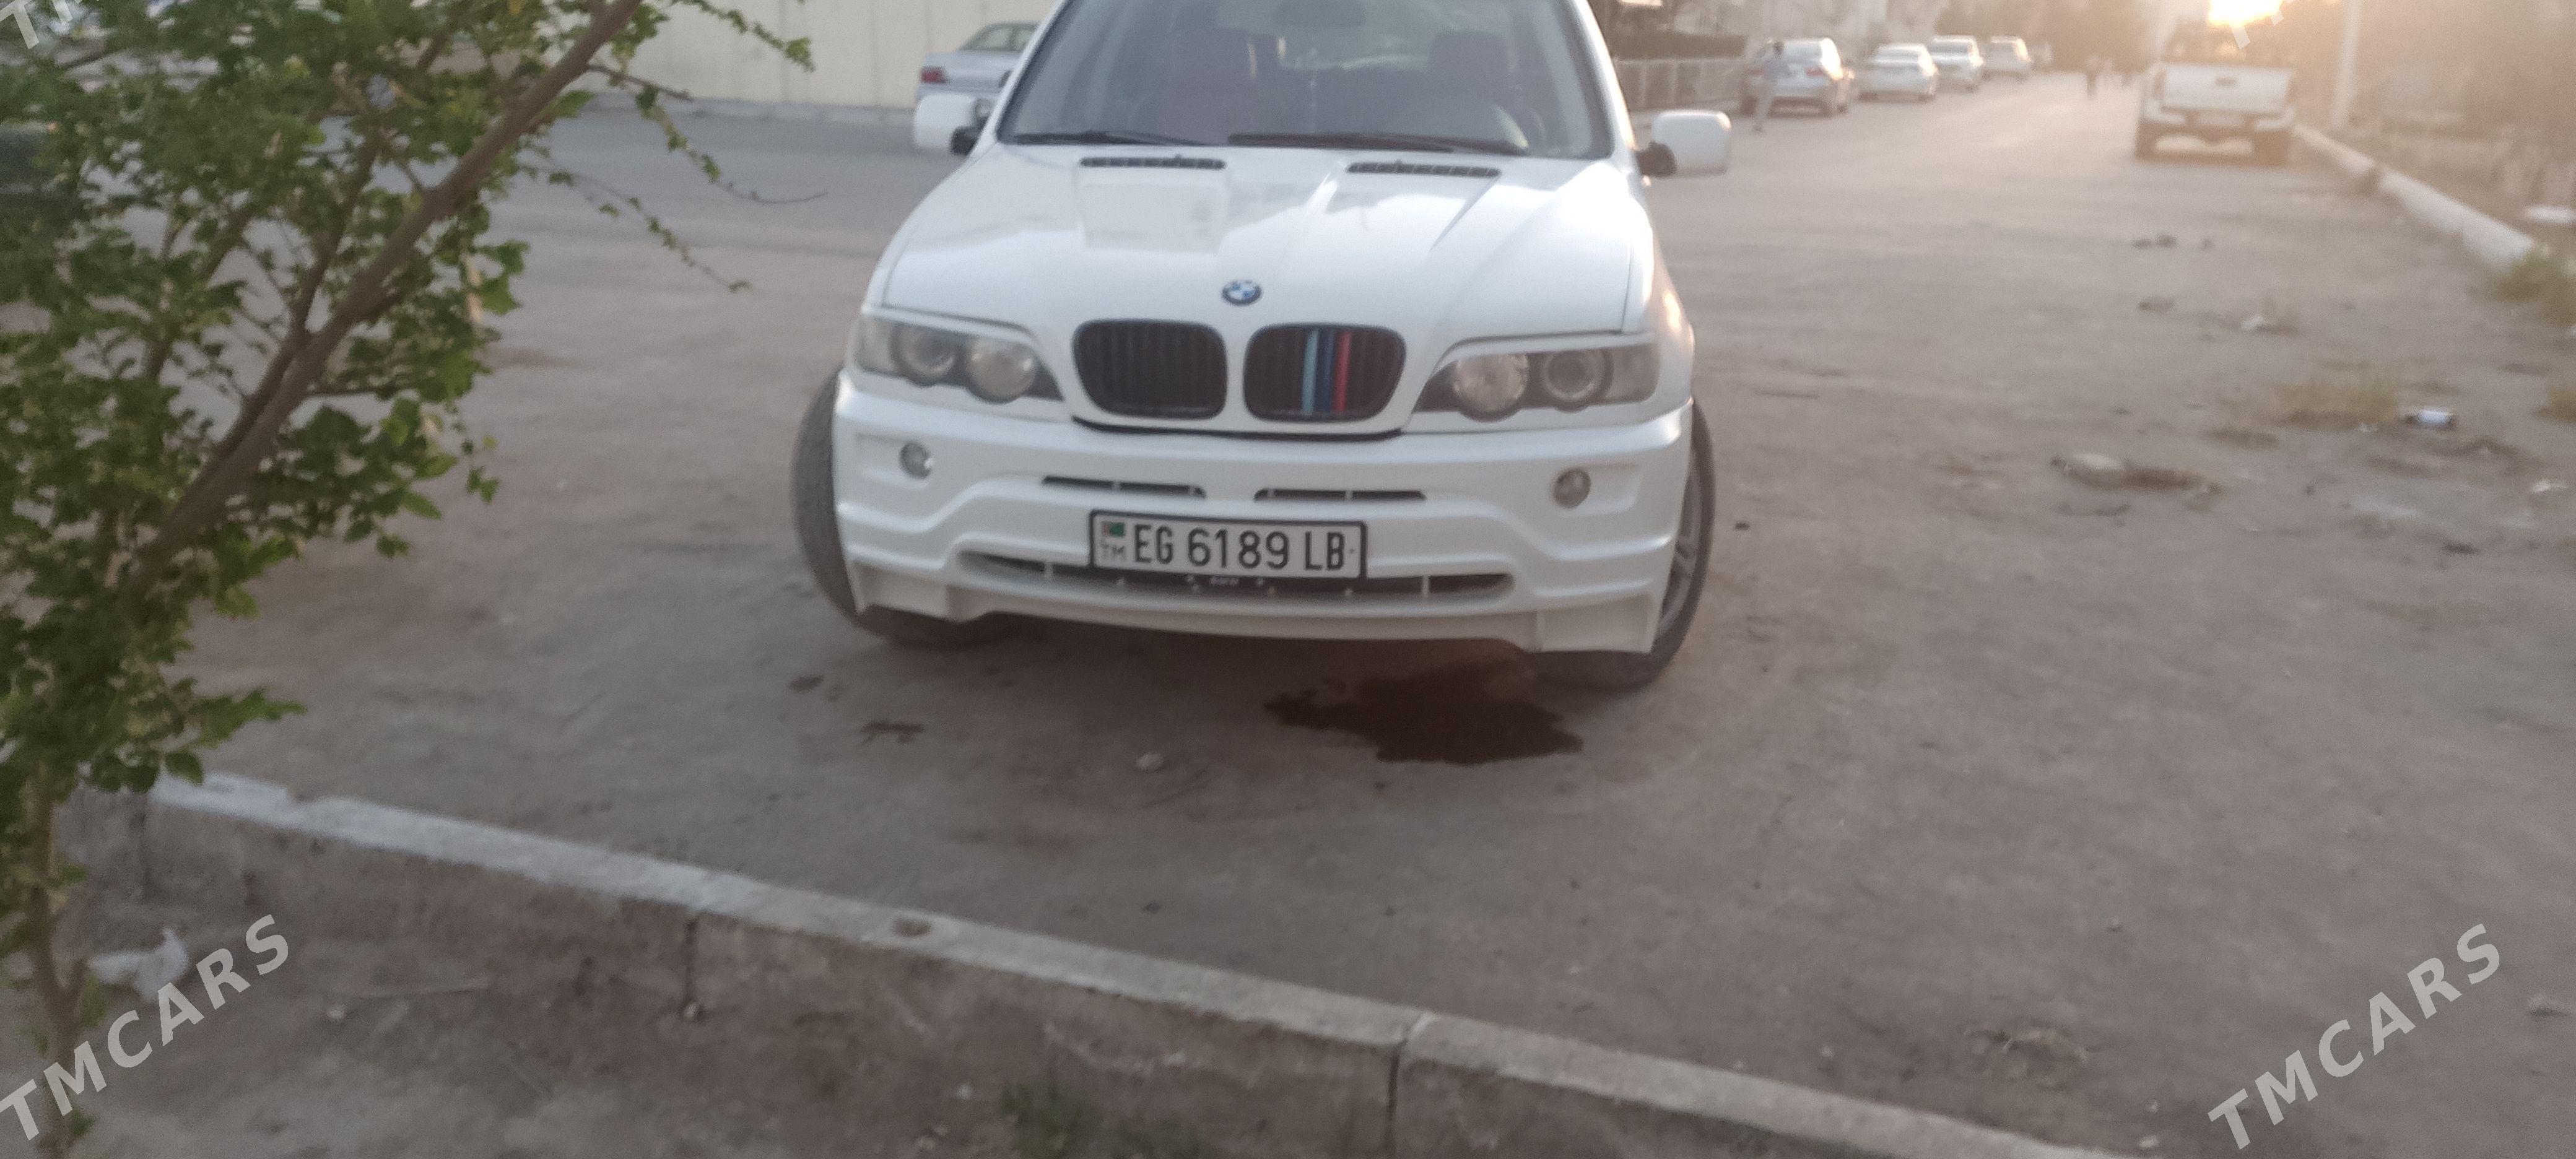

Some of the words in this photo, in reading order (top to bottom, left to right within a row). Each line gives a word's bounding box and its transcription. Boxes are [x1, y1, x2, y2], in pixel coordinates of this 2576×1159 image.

[1135, 524, 1175, 564] EG
[1188, 528, 1289, 569] 6189
[1305, 531, 1345, 570] LB
